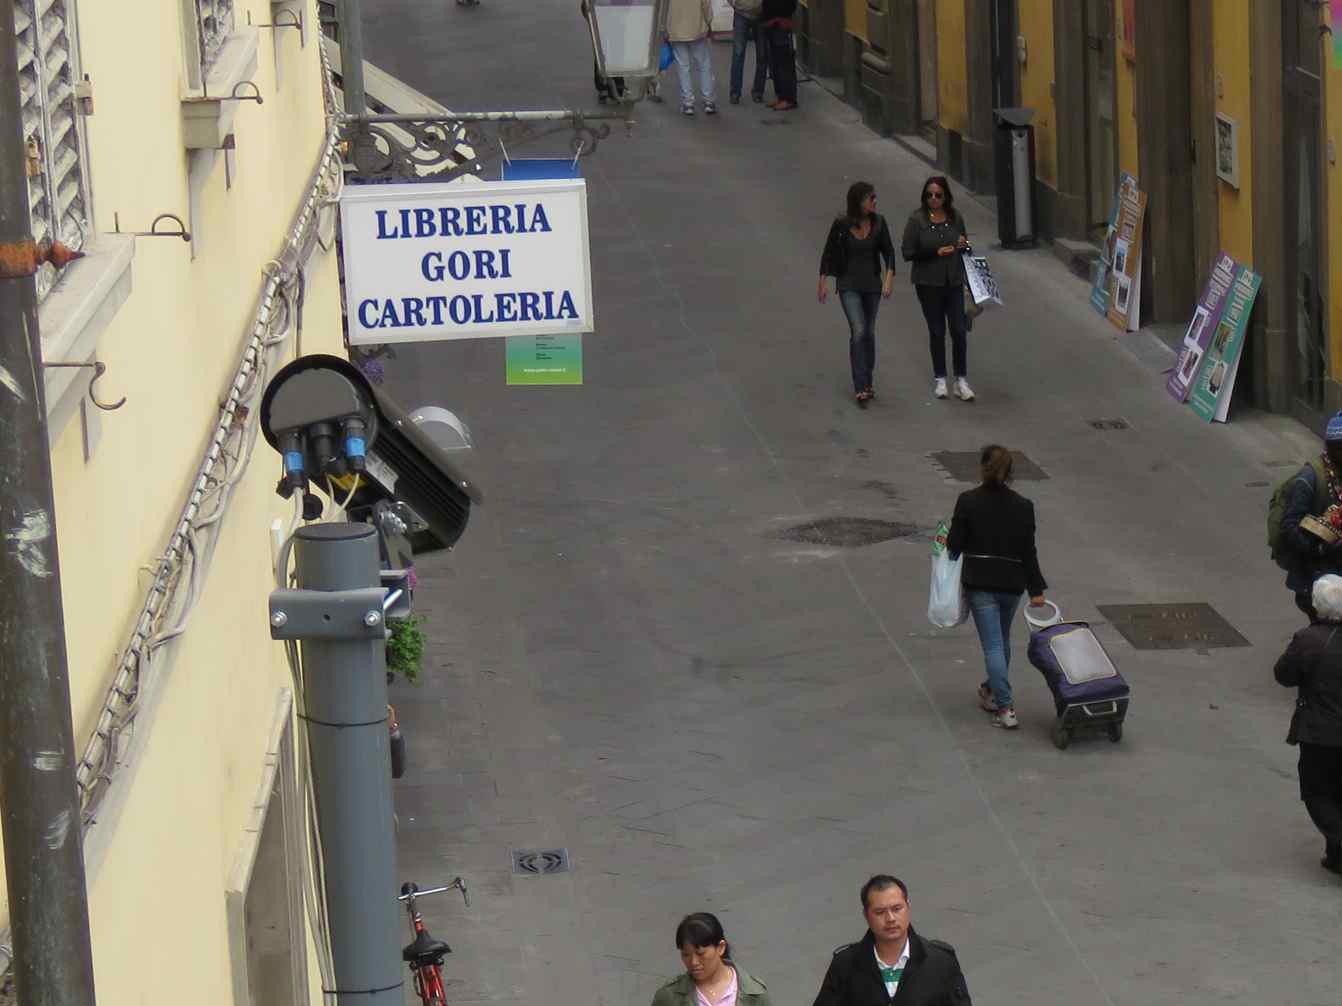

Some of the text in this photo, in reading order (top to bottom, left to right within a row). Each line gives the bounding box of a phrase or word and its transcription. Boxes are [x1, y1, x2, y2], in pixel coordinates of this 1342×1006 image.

[375, 203, 552, 240] LIBRERIA
[421, 248, 512, 282] GORI
[357, 289, 580, 329] CARTOLERIA
